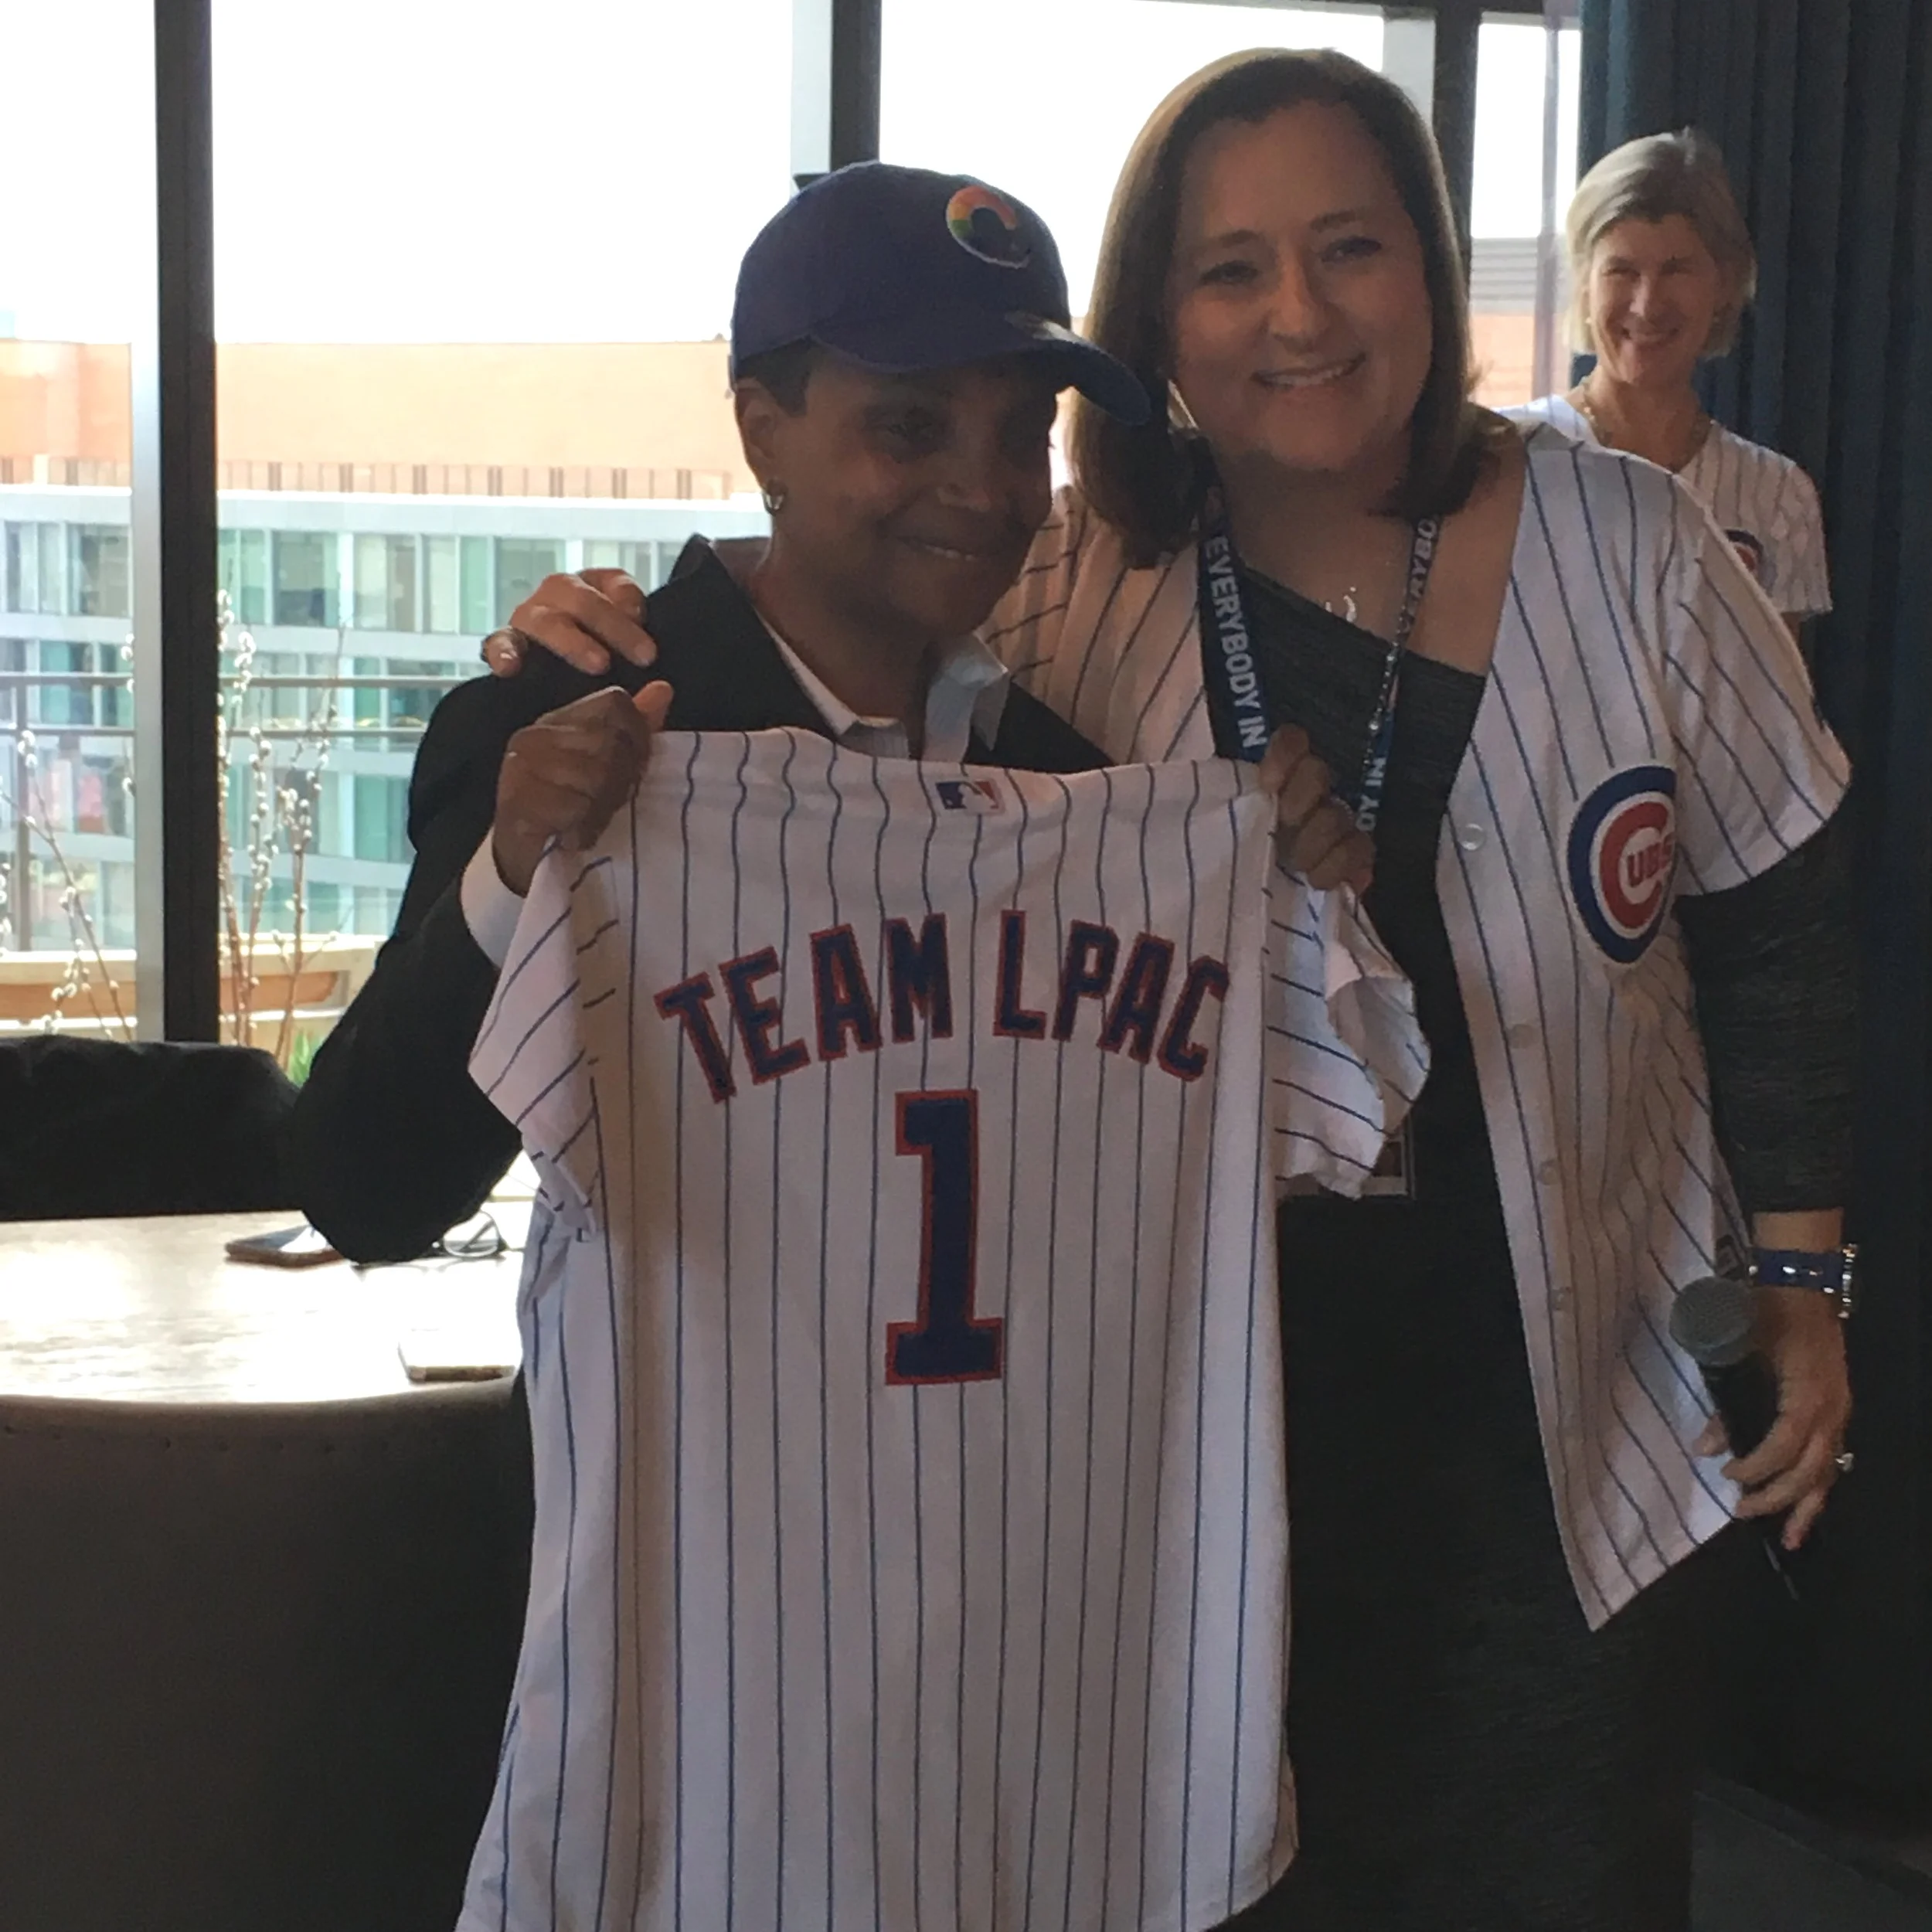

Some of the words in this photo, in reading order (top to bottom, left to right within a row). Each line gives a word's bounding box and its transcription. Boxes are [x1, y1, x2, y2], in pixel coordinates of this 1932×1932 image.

[1206, 535, 1262, 709] EVERYBODY
[1238, 715, 1268, 749] IN
[653, 913, 953, 1104] TEAM
[993, 909, 1230, 1083] LPAC
[886, 1088, 1003, 1386] 1
